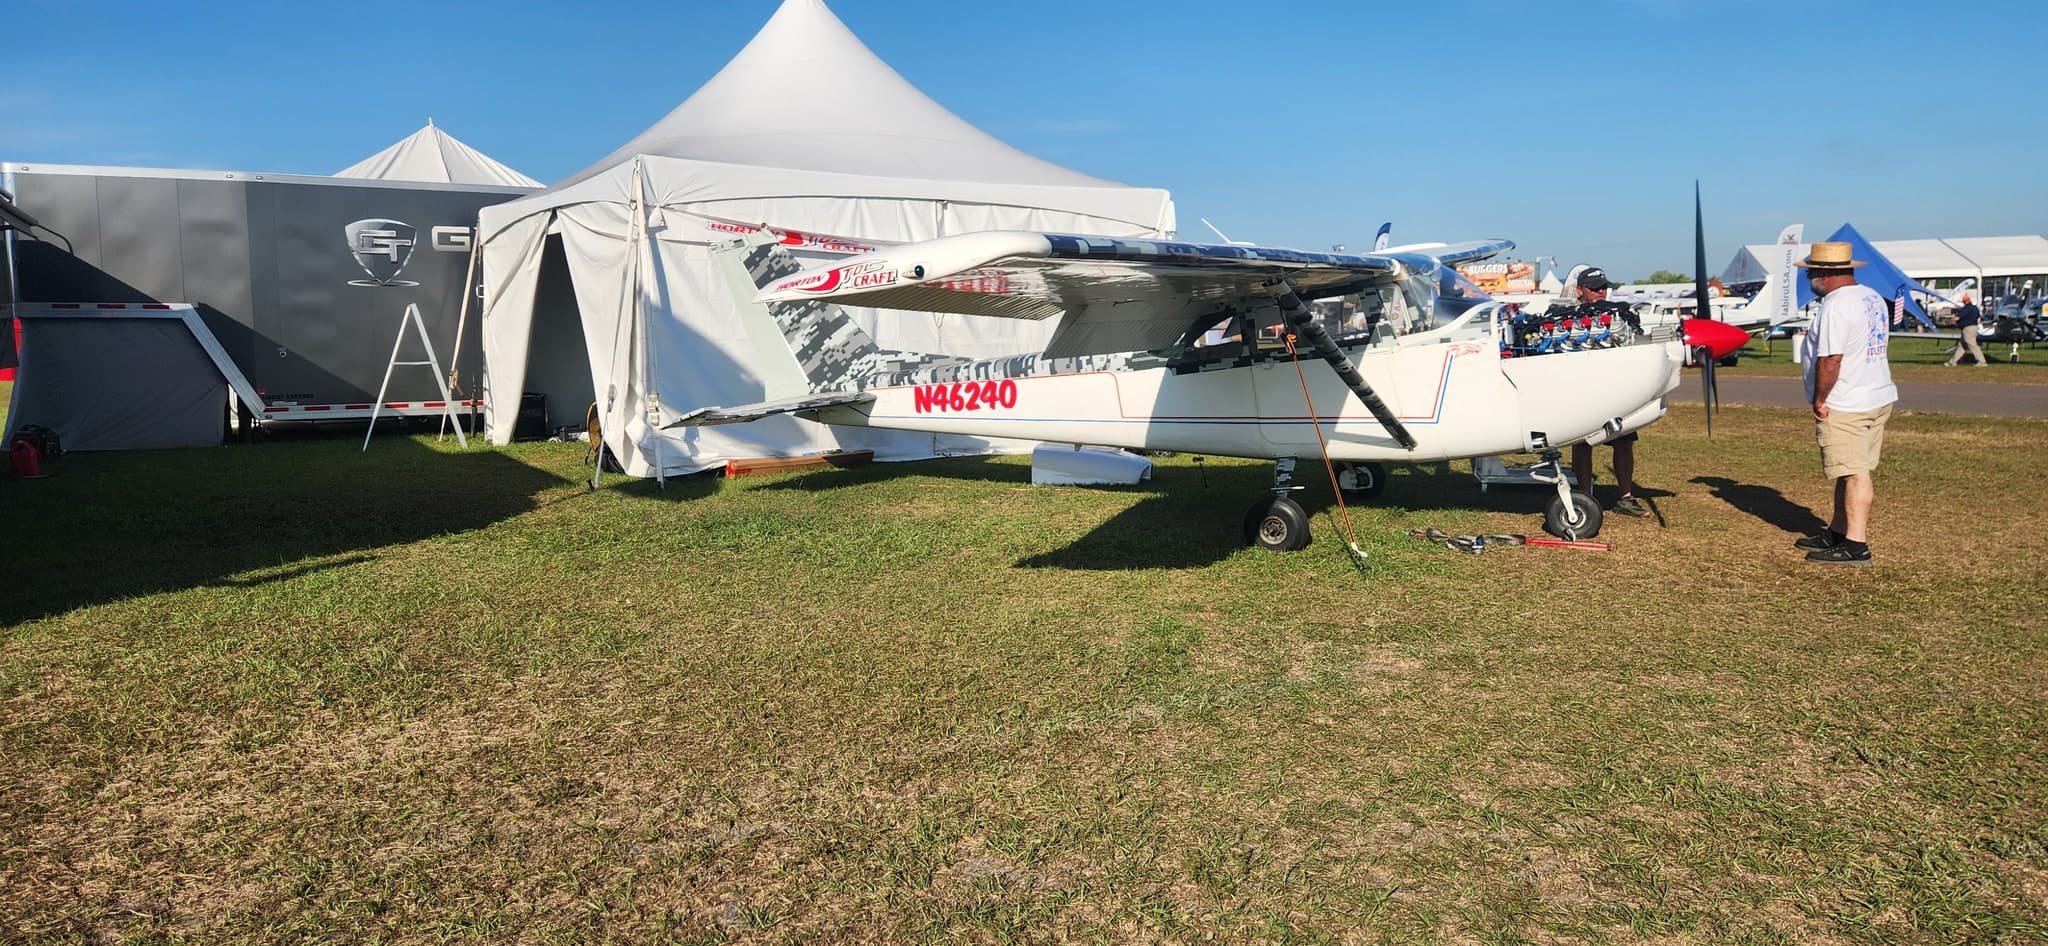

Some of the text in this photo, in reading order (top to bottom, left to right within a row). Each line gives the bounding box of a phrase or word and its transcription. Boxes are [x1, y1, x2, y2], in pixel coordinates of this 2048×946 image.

[359, 229, 412, 263] GT
[776, 274, 823, 291] HORTON
[853, 271, 896, 288] CRAFT
[914, 380, 1017, 413] N46240
